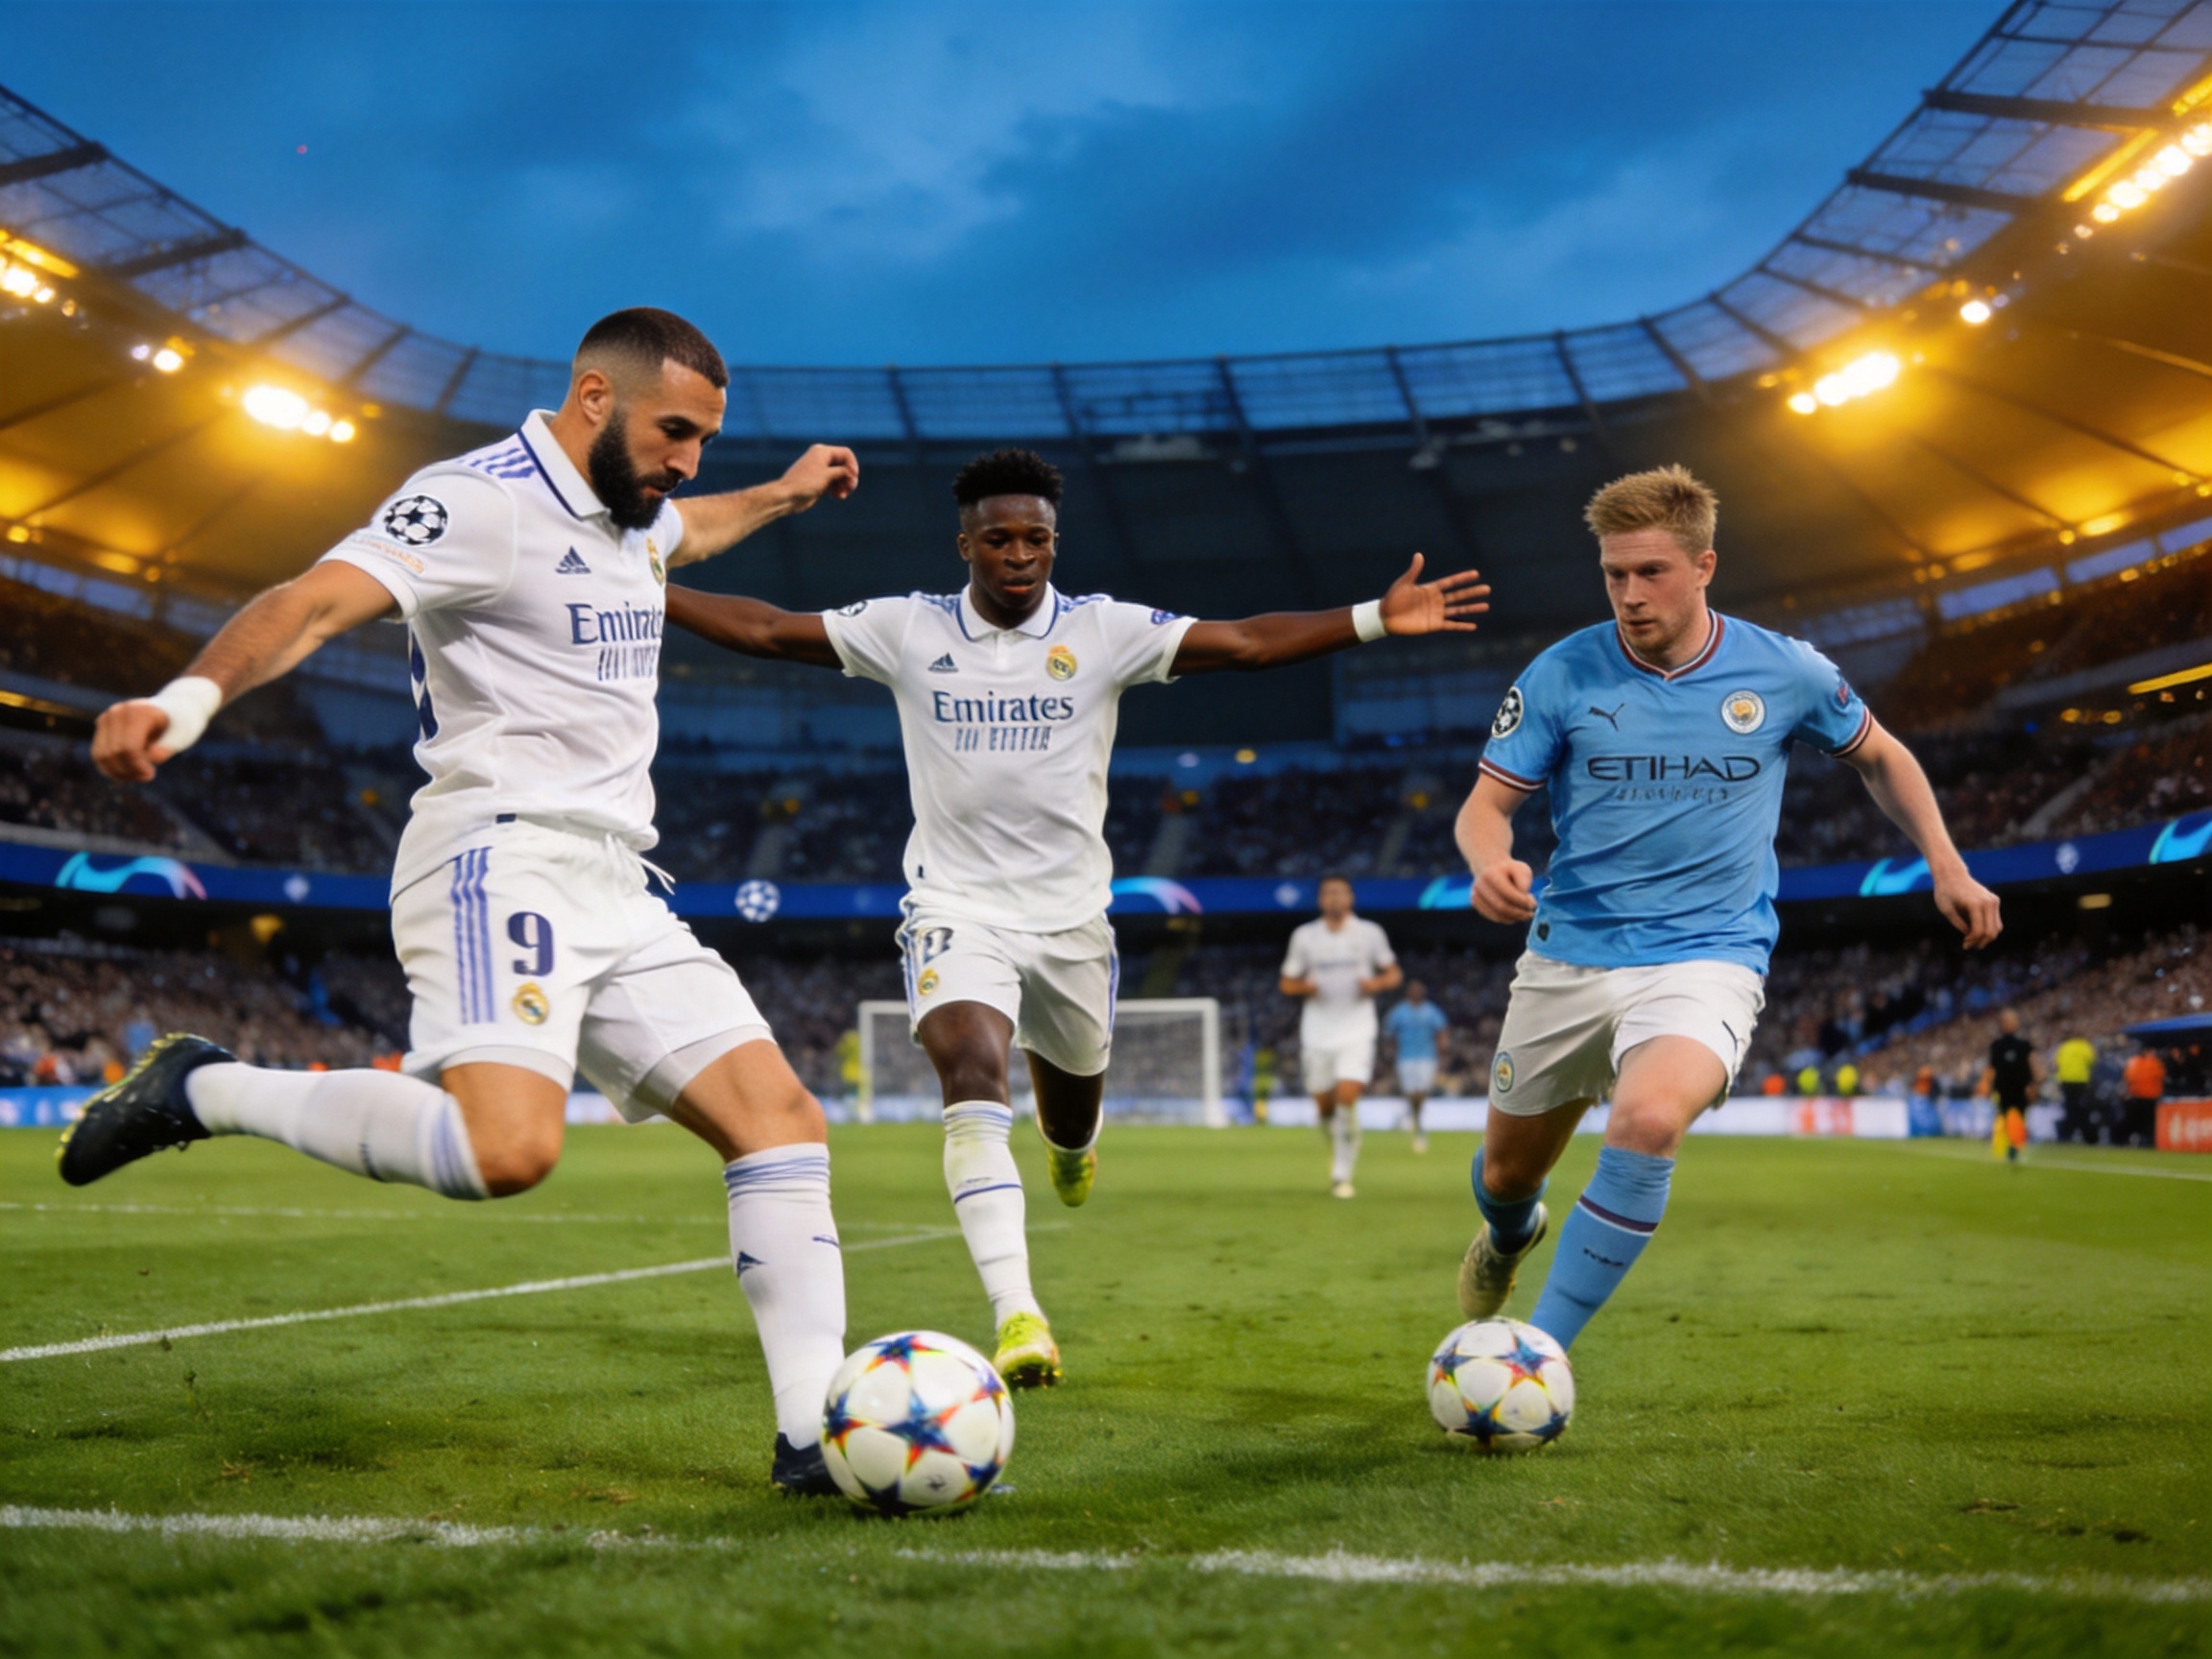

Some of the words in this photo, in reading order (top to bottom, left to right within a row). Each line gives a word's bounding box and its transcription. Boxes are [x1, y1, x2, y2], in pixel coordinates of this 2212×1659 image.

[932, 690, 1073, 722] Emirates
[1587, 756, 1761, 781] ETIHAD
[507, 911, 554, 976] 9
